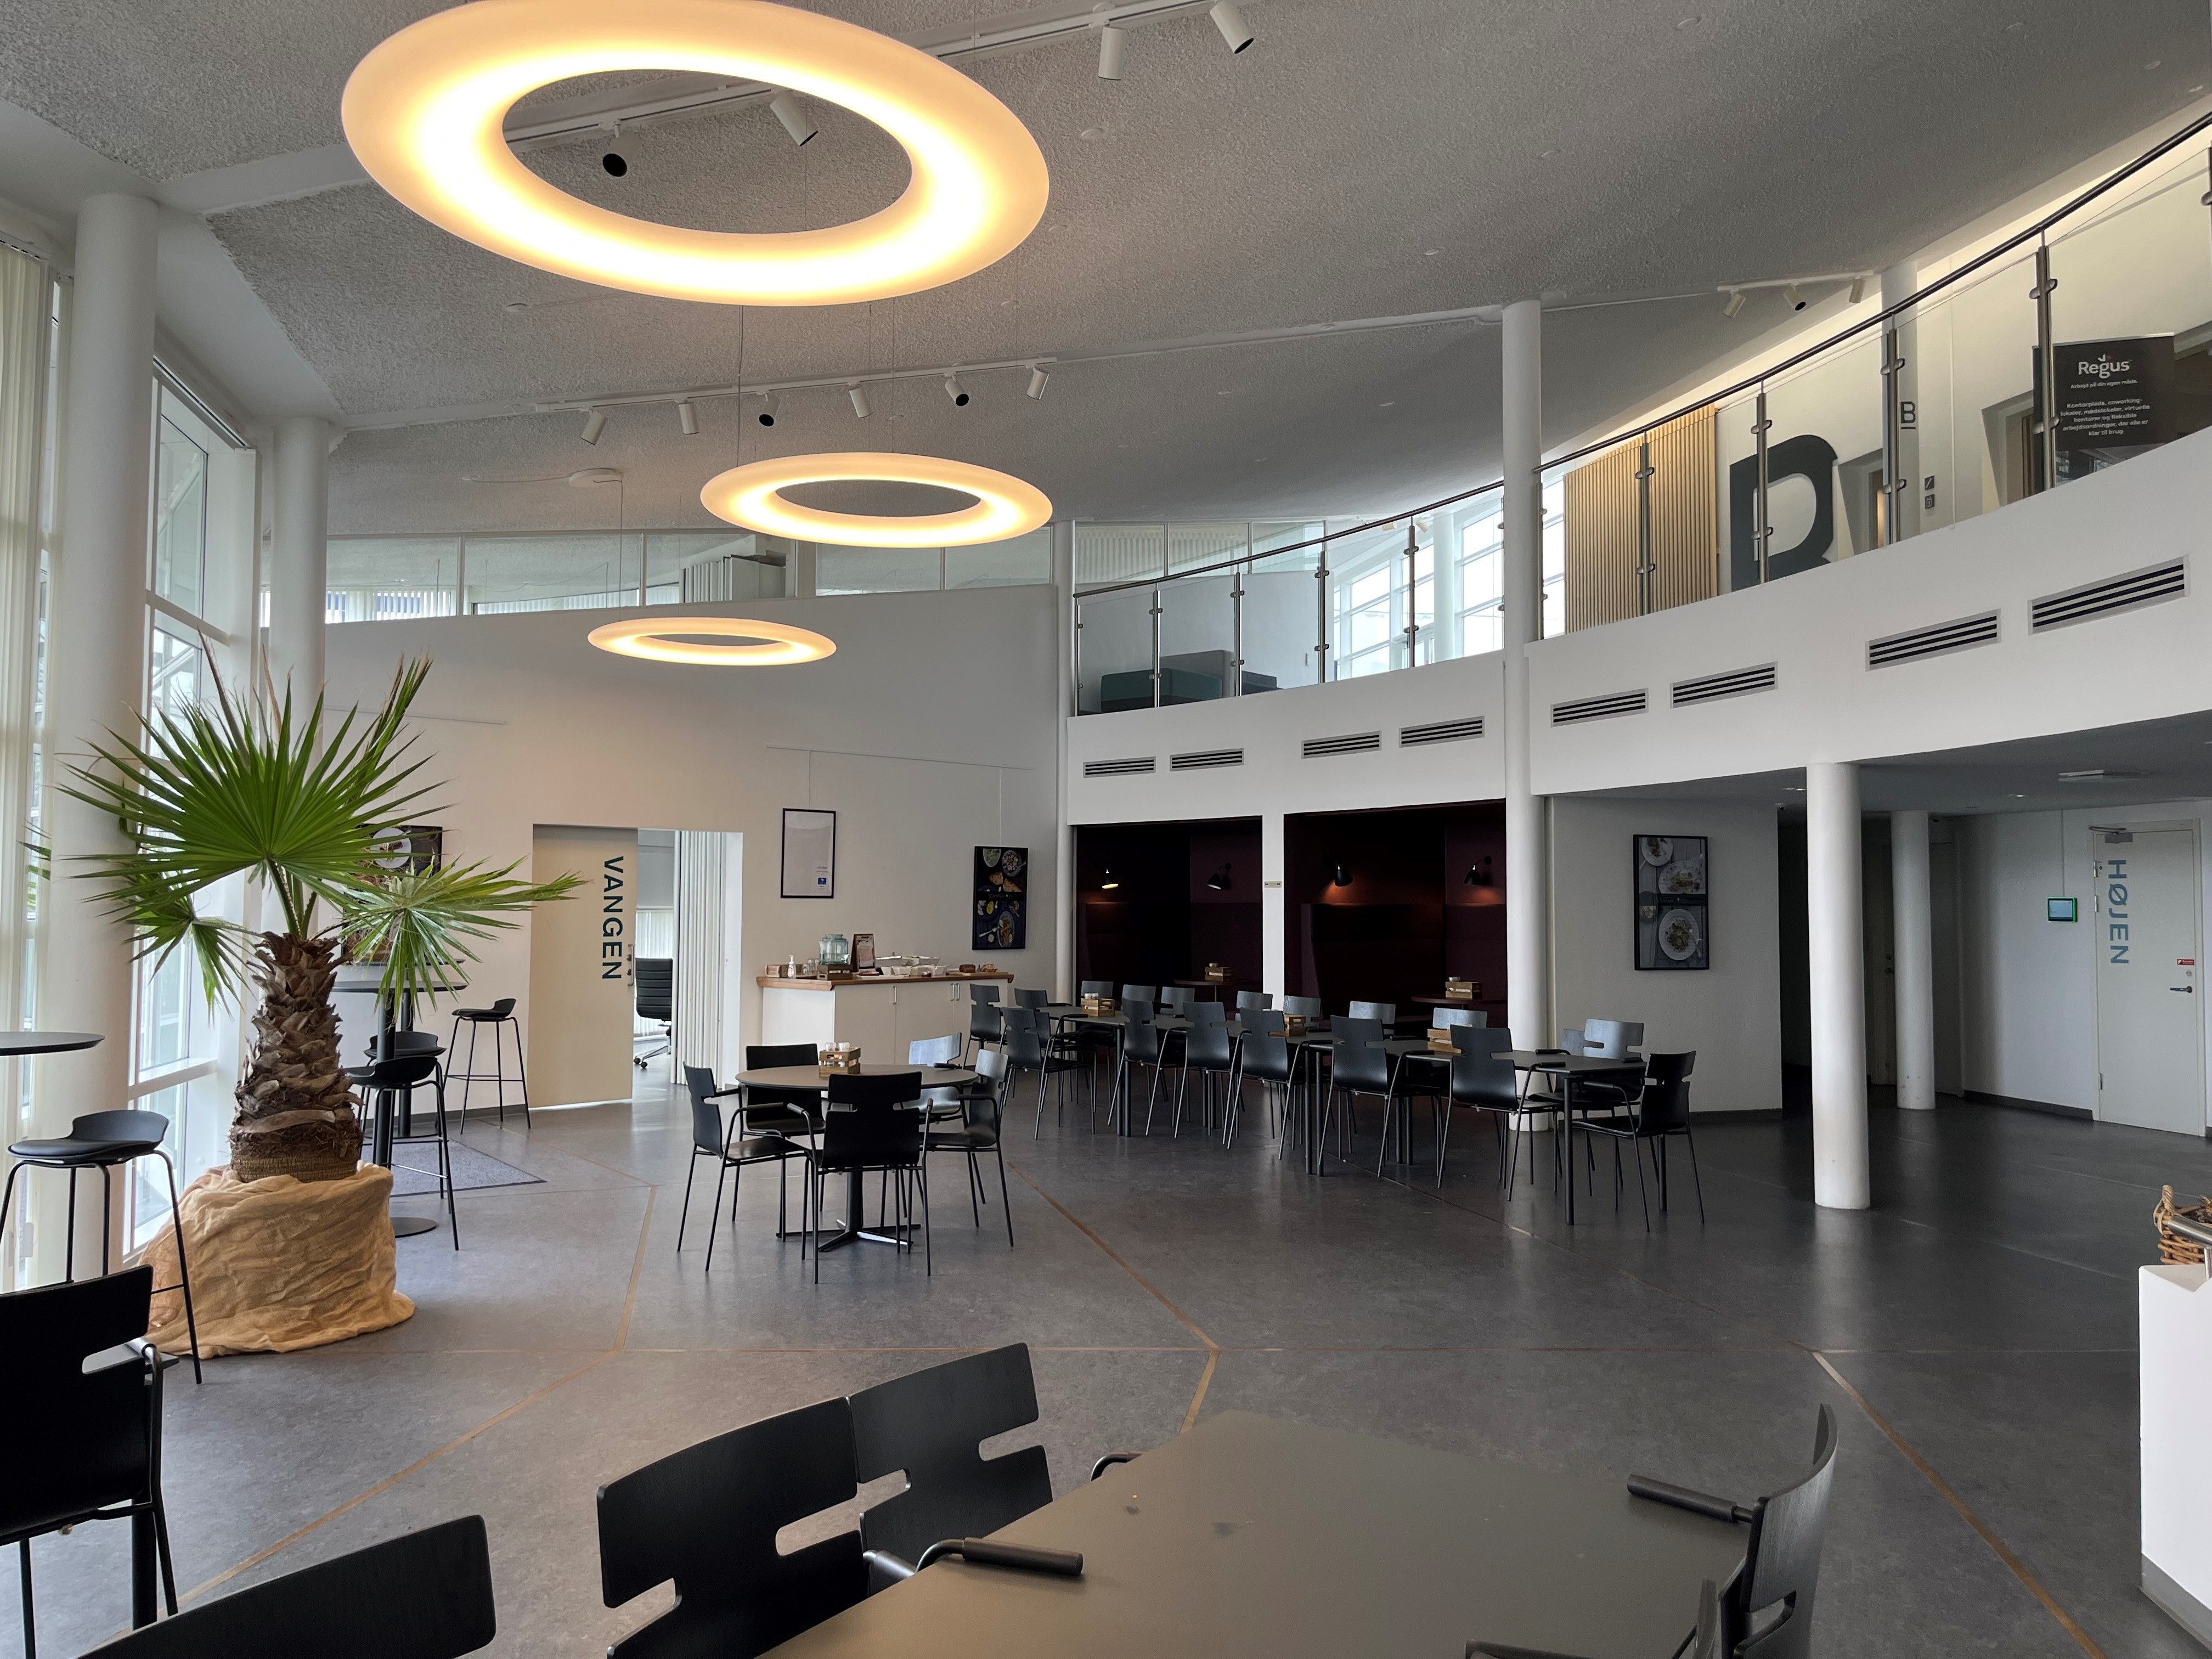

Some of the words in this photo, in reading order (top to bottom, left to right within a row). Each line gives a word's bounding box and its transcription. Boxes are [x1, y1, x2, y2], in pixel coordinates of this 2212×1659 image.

[2078, 361, 2130, 379] Regus
[1900, 401, 1916, 424] B
[602, 856, 624, 979] VANGEN
[2107, 860, 2129, 964] HØJEN
